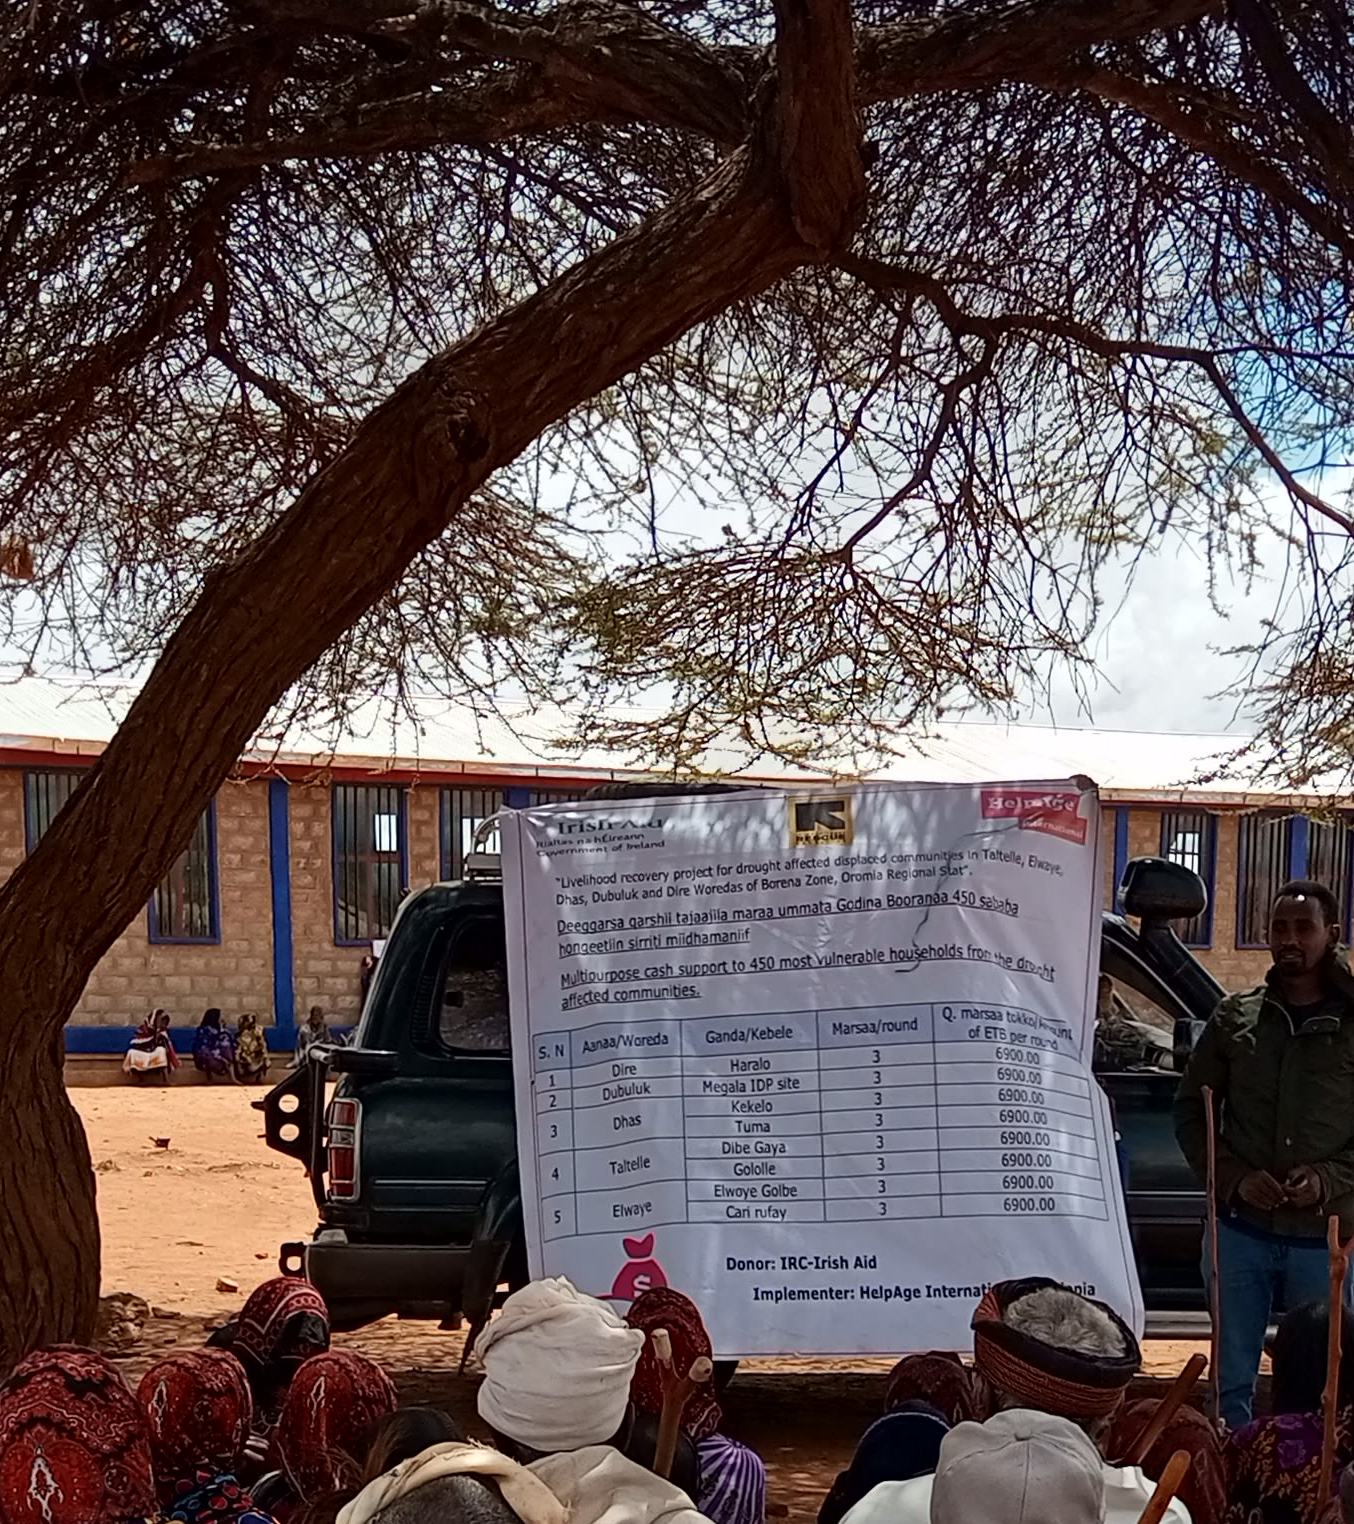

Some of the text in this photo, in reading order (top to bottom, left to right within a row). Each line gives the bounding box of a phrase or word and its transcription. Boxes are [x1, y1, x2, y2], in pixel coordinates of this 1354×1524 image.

[612, 844, 622, 852] of
[627, 840, 665, 850] Ireland
[621, 870, 669, 883] recovery
[673, 866, 713, 882] project
[716, 864, 732, 876] for
[736, 861, 781, 875] drought
[785, 857, 830, 870] affected
[834, 853, 886, 868] displaced
[891, 850, 963, 863] communities
[968, 850, 978, 861] in
[556, 893, 588, 906] Dhas,
[592, 889, 639, 903] Dubuluk
[642, 886, 663, 899] and
[667, 885, 690, 898] Dire
[694, 881, 743, 897] Woredas
[746, 878, 759, 891] of
[761, 877, 801, 890] Borena
[805, 874, 838, 887] Zone,
[841, 870, 883, 883] Oromia
[887, 866, 935, 881] Regional
[733, 907, 774, 919] maraa
[778, 901, 832, 917] ummata
[837, 897, 882, 911] Godina
[887, 892, 948, 908] Booranaa
[953, 890, 976, 904] 450
[644, 963, 674, 978] cash
[679, 961, 728, 977] support
[732, 960, 745, 972] to
[750, 957, 775, 970] 450
[780, 954, 813, 969] most
[818, 948, 885, 966] vulnerable
[889, 944, 963, 961] households
[561, 984, 701, 1010] affected communities.
[942, 1006, 956, 1023] Q.
[961, 1008, 1003, 1021] marsaa
[832, 1018, 918, 1036] Marsaa/round
[968, 1025, 981, 1039] of
[1010, 1032, 1028, 1044] per
[705, 1026, 794, 1044] Ganda/Kebele
[538, 1044, 565, 1059] S. N
[872, 1050, 881, 1063] 3
[995, 1047, 1040, 1065] 6900.00
[612, 1063, 637, 1078] Dire
[730, 1058, 771, 1072] Haralo
[549, 1075, 556, 1087] 1
[873, 1072, 881, 1084] 3
[997, 1067, 1042, 1085] 6900.00
[603, 1081, 651, 1101] Dubuluk
[702, 1077, 800, 1096] Megala IDP site
[549, 1095, 557, 1107] 2
[874, 1093, 882, 1105] 3
[998, 1089, 1044, 1104] 6900.00
[731, 1099, 773, 1113] Kekelo
[613, 1113, 642, 1130] Dhas
[875, 1114, 883, 1126] 3
[999, 1110, 1047, 1125] 6900.00
[550, 1125, 558, 1138] 3
[734, 1120, 771, 1133] Tuma
[876, 1136, 884, 1149] 3
[1000, 1131, 1050, 1146] 6900.00
[722, 1141, 786, 1157] Dibe Gaya
[609, 1156, 651, 1176] Taltelle
[877, 1158, 885, 1171] 3
[1001, 1153, 1052, 1168] 6900.00
[551, 1168, 559, 1180] 4
[733, 1162, 776, 1176] Gololle
[761, 1183, 798, 1197] Golbe
[878, 1180, 886, 1193] 3
[1002, 1175, 1053, 1190] 6900.00
[612, 1200, 653, 1218] Elwaye
[879, 1202, 887, 1215] 3
[1004, 1198, 1055, 1212] 6900.00
[554, 1210, 561, 1223] 5
[726, 1204, 787, 1222] Cari rufay
[726, 1255, 878, 1271] Donor: IRC-Irish Aid
[753, 1286, 855, 1304] Implementer:
[859, 1285, 921, 1302] HelpAge
[925, 1282, 992, 1298] Internati
